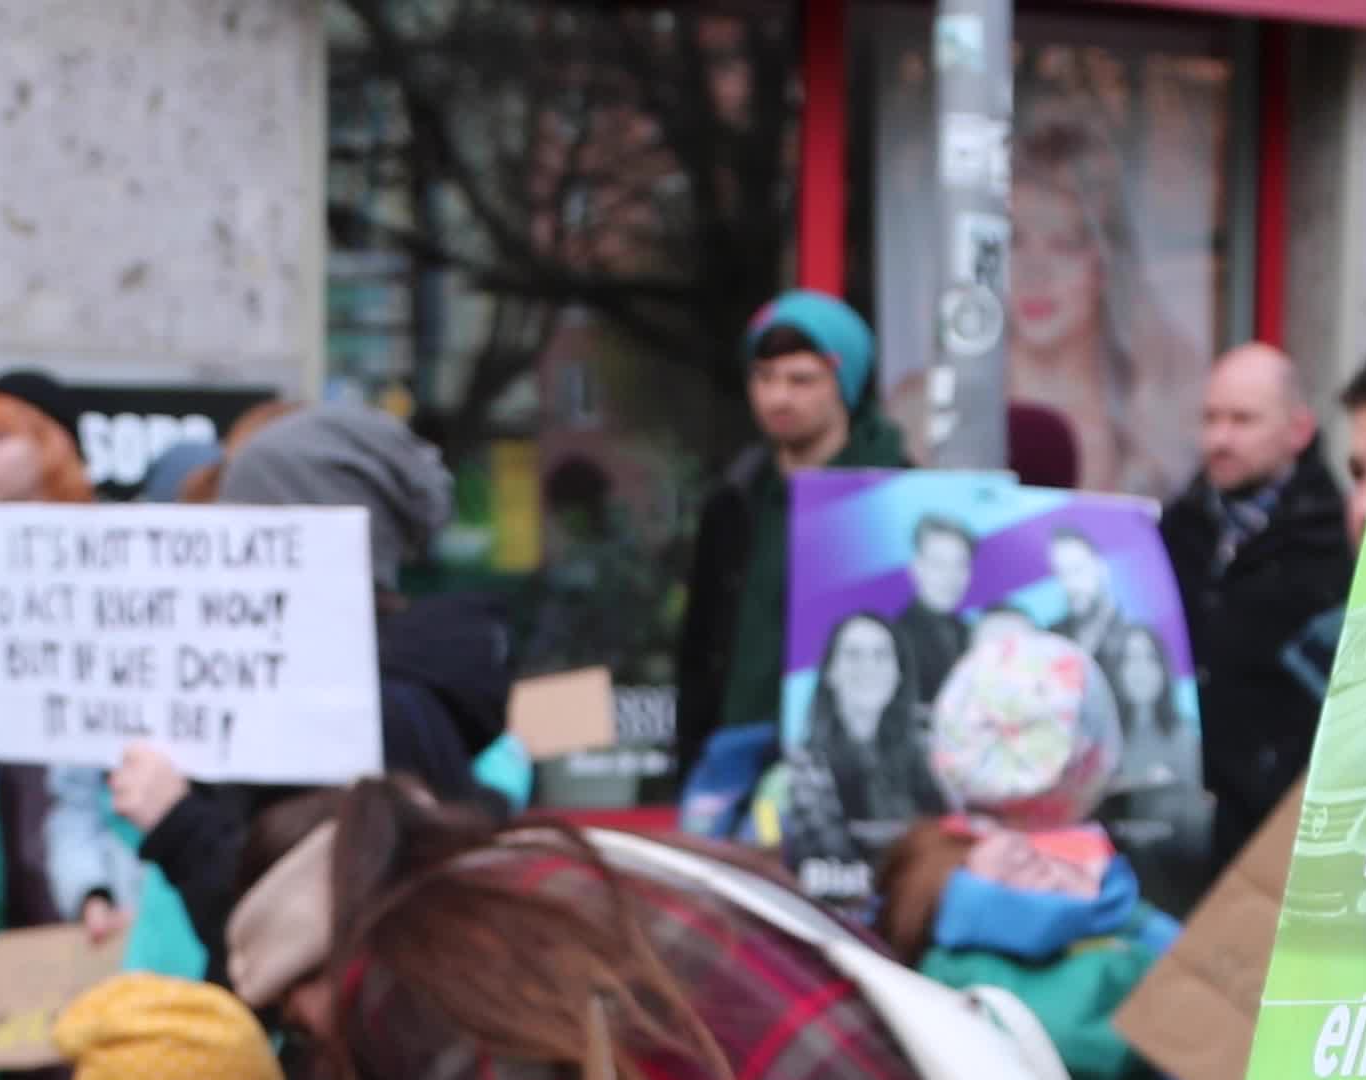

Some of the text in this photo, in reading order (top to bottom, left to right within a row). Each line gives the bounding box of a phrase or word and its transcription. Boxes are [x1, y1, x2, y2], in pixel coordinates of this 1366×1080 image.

[77, 526, 132, 570] NOT
[146, 528, 212, 569] TOO
[221, 525, 304, 570] LATE
[22, 588, 75, 627] ACT
[92, 587, 179, 629] RIGHT
[4, 639, 60, 682] BUT
[72, 641, 99, 684] IF
[109, 645, 157, 690] WE
[44, 692, 69, 738] IT
[79, 699, 154, 738] WILL
